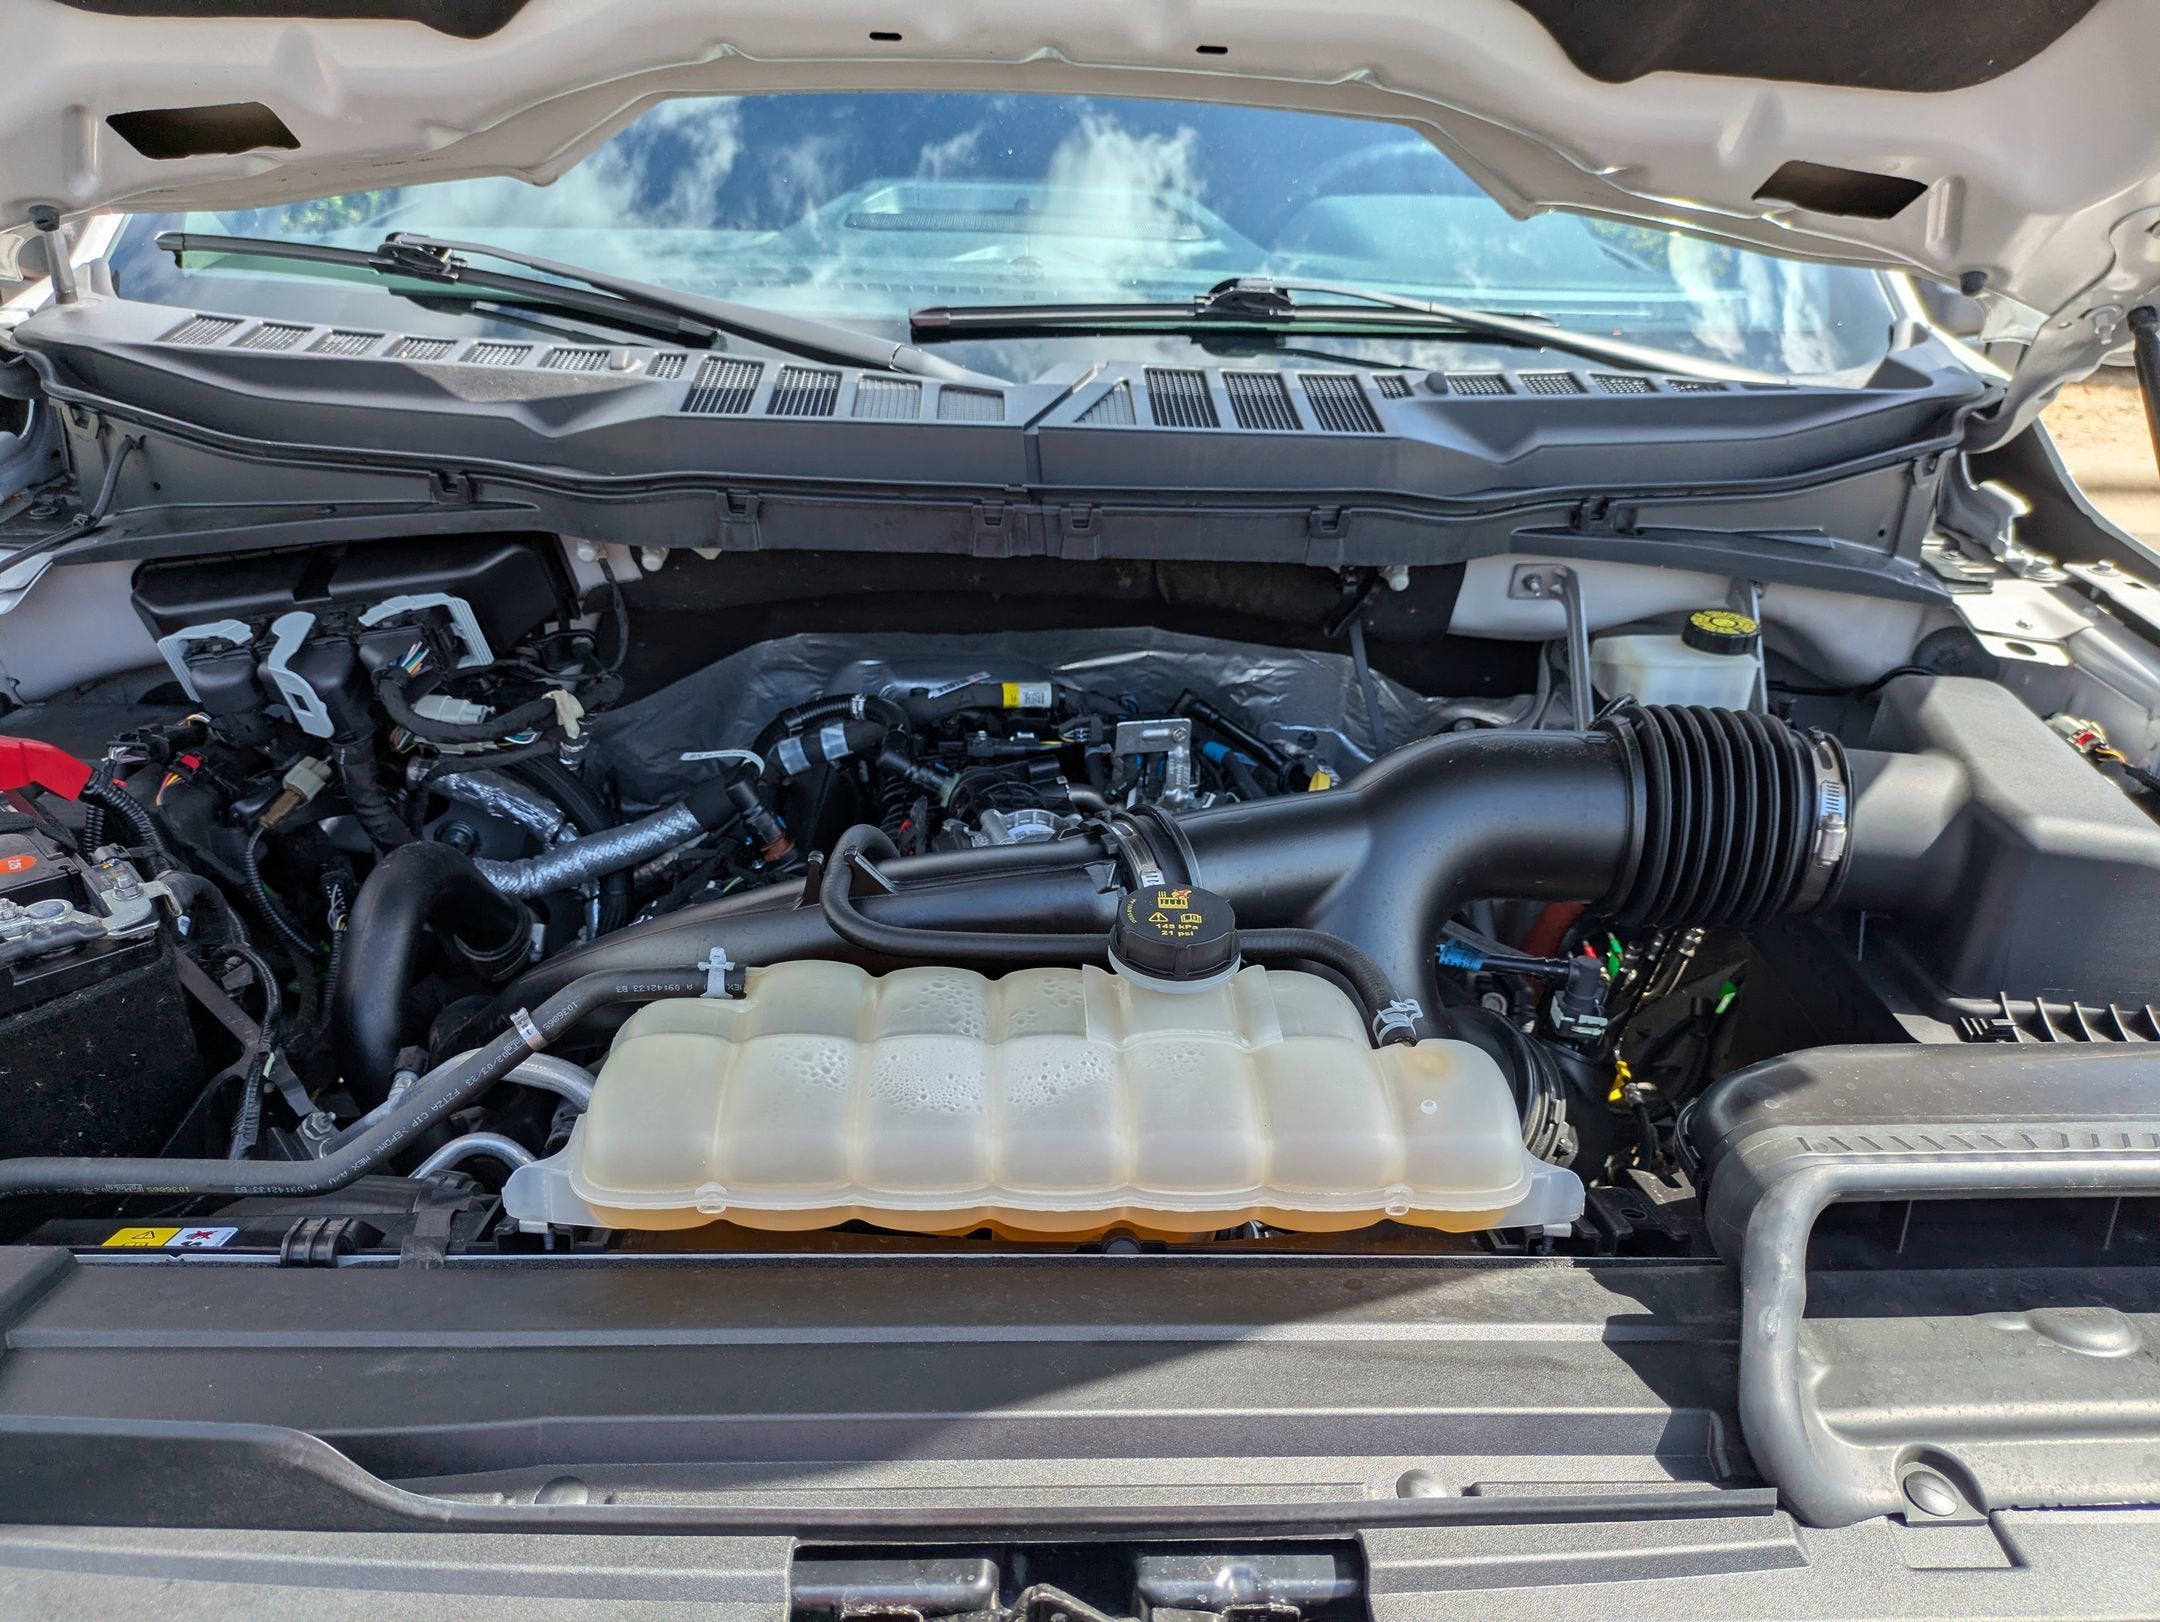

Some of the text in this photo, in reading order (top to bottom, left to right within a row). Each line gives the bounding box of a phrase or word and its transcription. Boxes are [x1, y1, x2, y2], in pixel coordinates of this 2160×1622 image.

[615, 985, 628, 993] B3
[633, 984, 681, 992] 09:42:33
[464, 1051, 508, 1087] 02/03/23
[411, 1111, 429, 1127] CIP
[351, 1154, 372, 1172] MEX
[328, 1170, 348, 1185] A/U
[252, 1185, 304, 1193] 09:42:33
[309, 1183, 318, 1191] A
